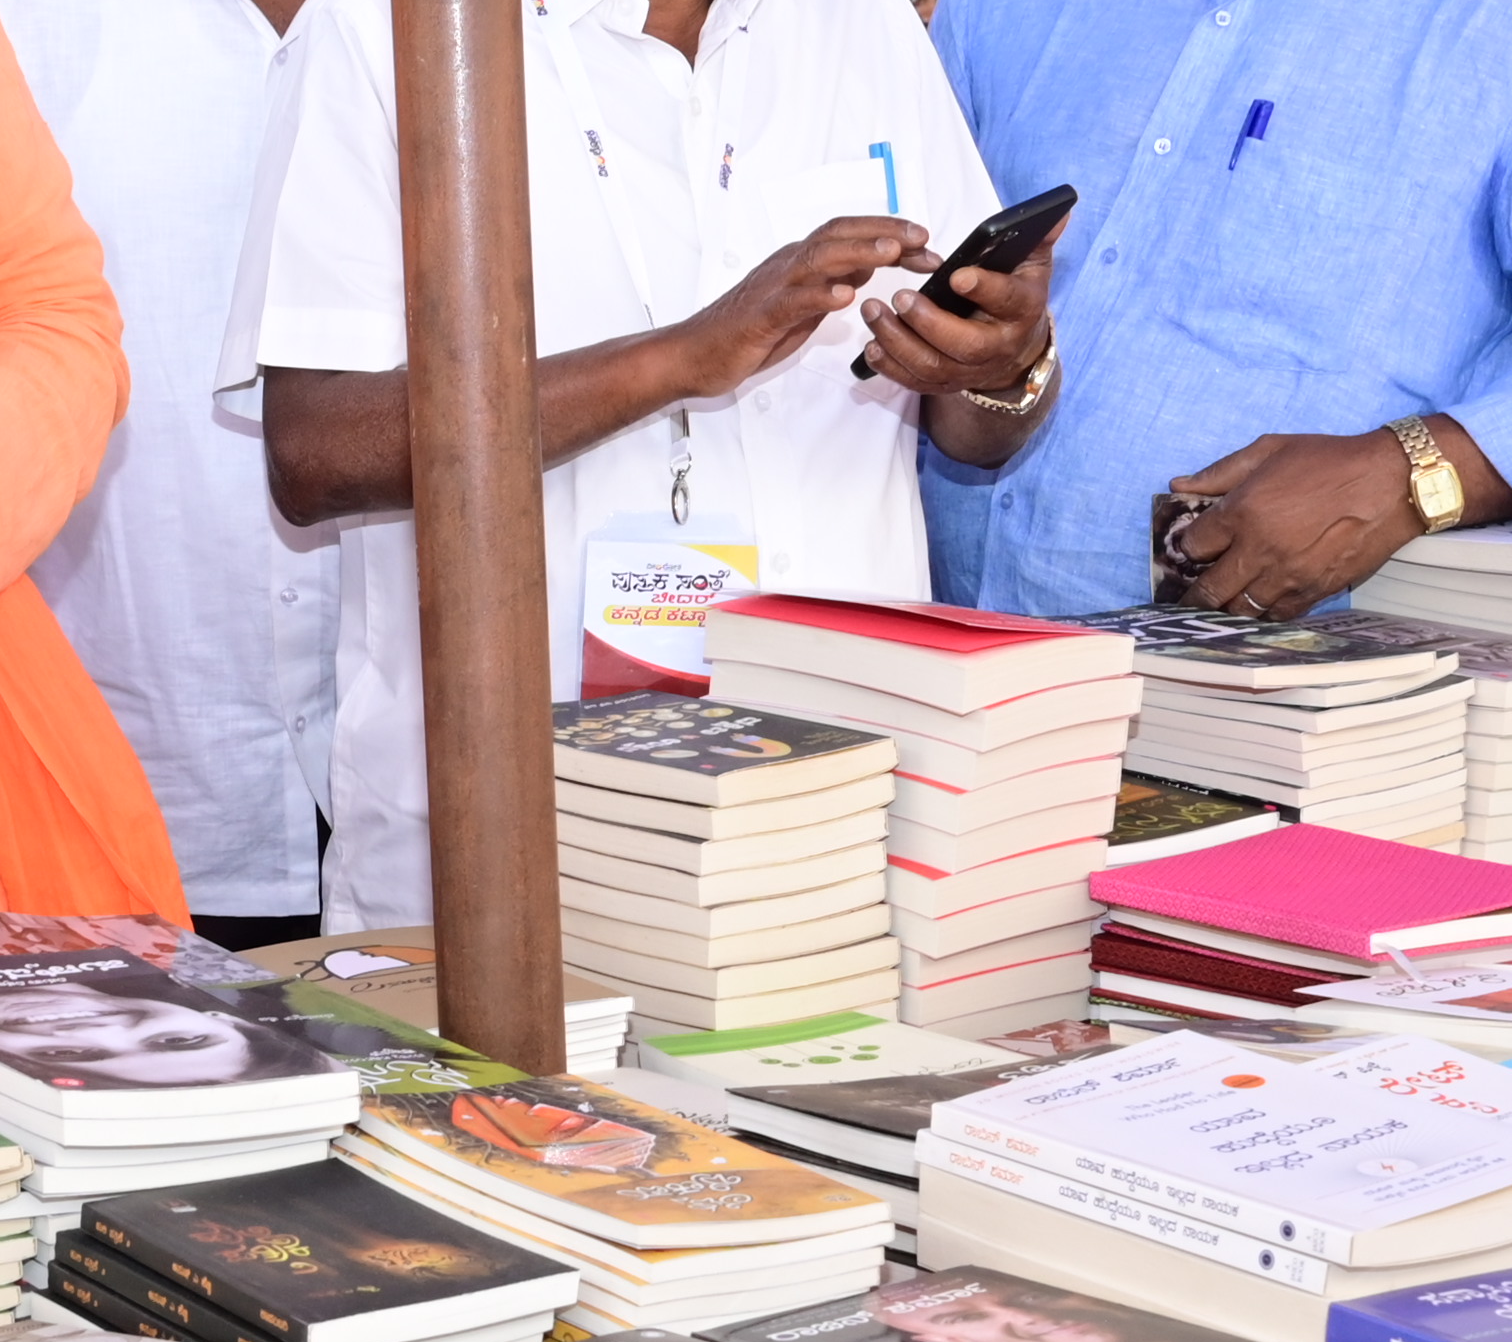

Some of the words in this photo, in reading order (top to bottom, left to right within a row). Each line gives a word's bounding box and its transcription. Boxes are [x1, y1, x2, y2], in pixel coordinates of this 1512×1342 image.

[610, 570, 668, 592] ಪುಸ್ತಕ
[609, 606, 660, 626] ಕನ್ನಡ
[650, 592, 717, 606] ಬೀದರ್
[1022, 1076, 1102, 1107] ರಾಬಿನ್
[1109, 1054, 1180, 1085] ಶರ್ಮಾ
[1187, 1108, 1267, 1135] ಯಾವ
[1317, 1119, 1410, 1153] ನಾಯಕ
[962, 1120, 1005, 1148] ರಾಬಿನ್
[1005, 1138, 1041, 1158] ಶರ್ಮಾ
[1074, 1152, 1106, 1174] ಯಾವ
[1201, 1192, 1241, 1218] ನಾಯಕ
[947, 1148, 988, 1176] ರಾಬಿನ್
[989, 1166, 1026, 1186] ಶರ್ಮಾ
[1057, 1180, 1089, 1202] ಯಾವ
[1181, 1223, 1222, 1248] ನಾಯಕ
[881, 1282, 989, 1320] ಶರ್ಮಾ
